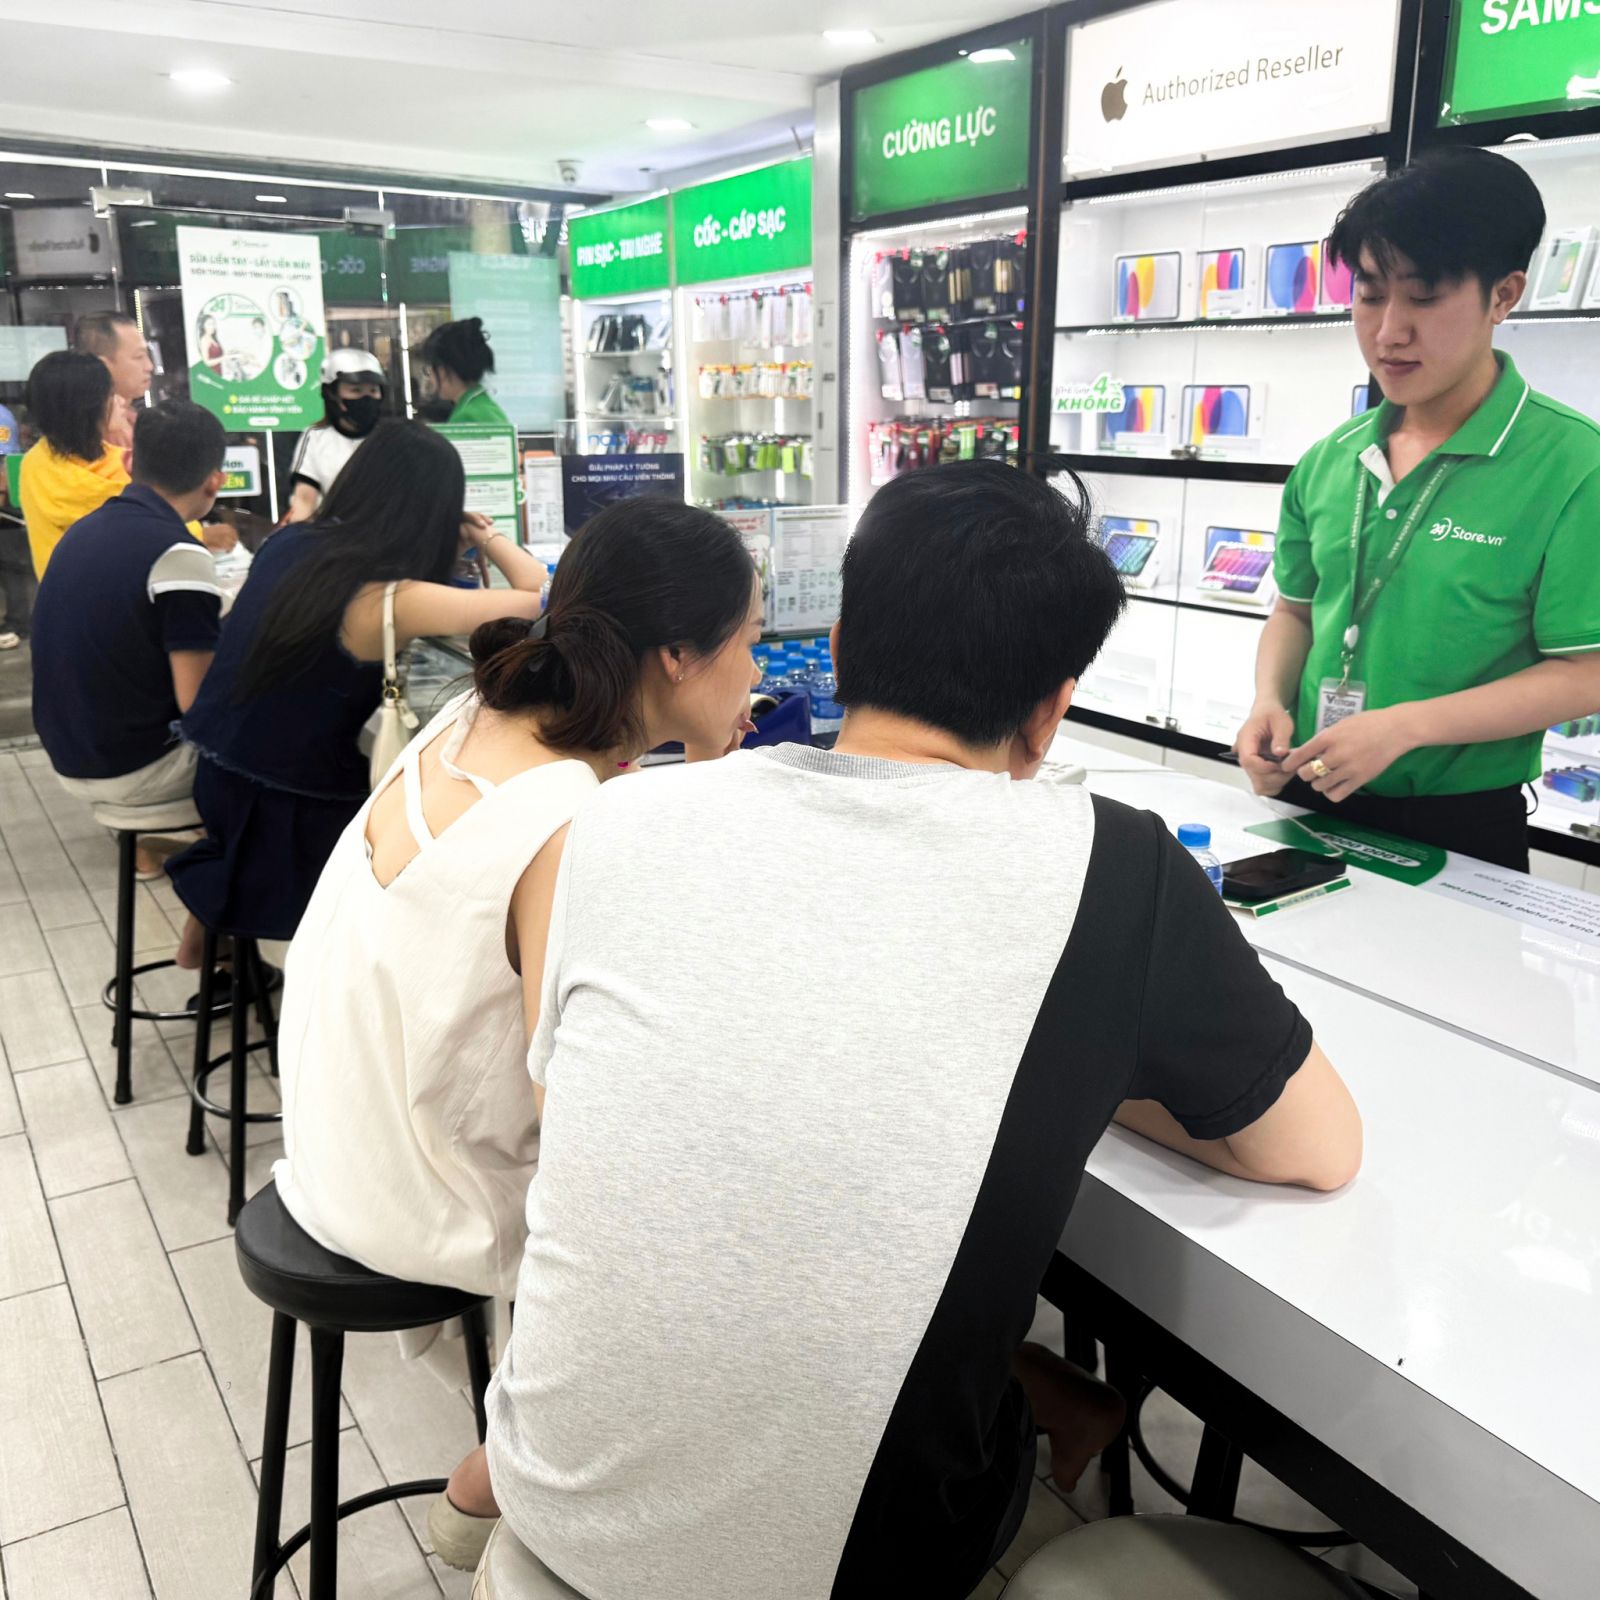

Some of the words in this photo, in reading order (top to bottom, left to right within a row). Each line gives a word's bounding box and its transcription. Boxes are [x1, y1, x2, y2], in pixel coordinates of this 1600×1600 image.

[1142, 59, 1250, 106] Authorized
[1256, 44, 1344, 82] Reseller
[882, 117, 951, 159] CƯỜNG
[955, 104, 997, 147] LỰC
[694, 213, 721, 248] CỐC
[728, 207, 757, 241] CÁP
[756, 206, 786, 240] SẠC
[1056, 395, 1121, 411] KHÔNG
[1093, 375, 1108, 395] 4
